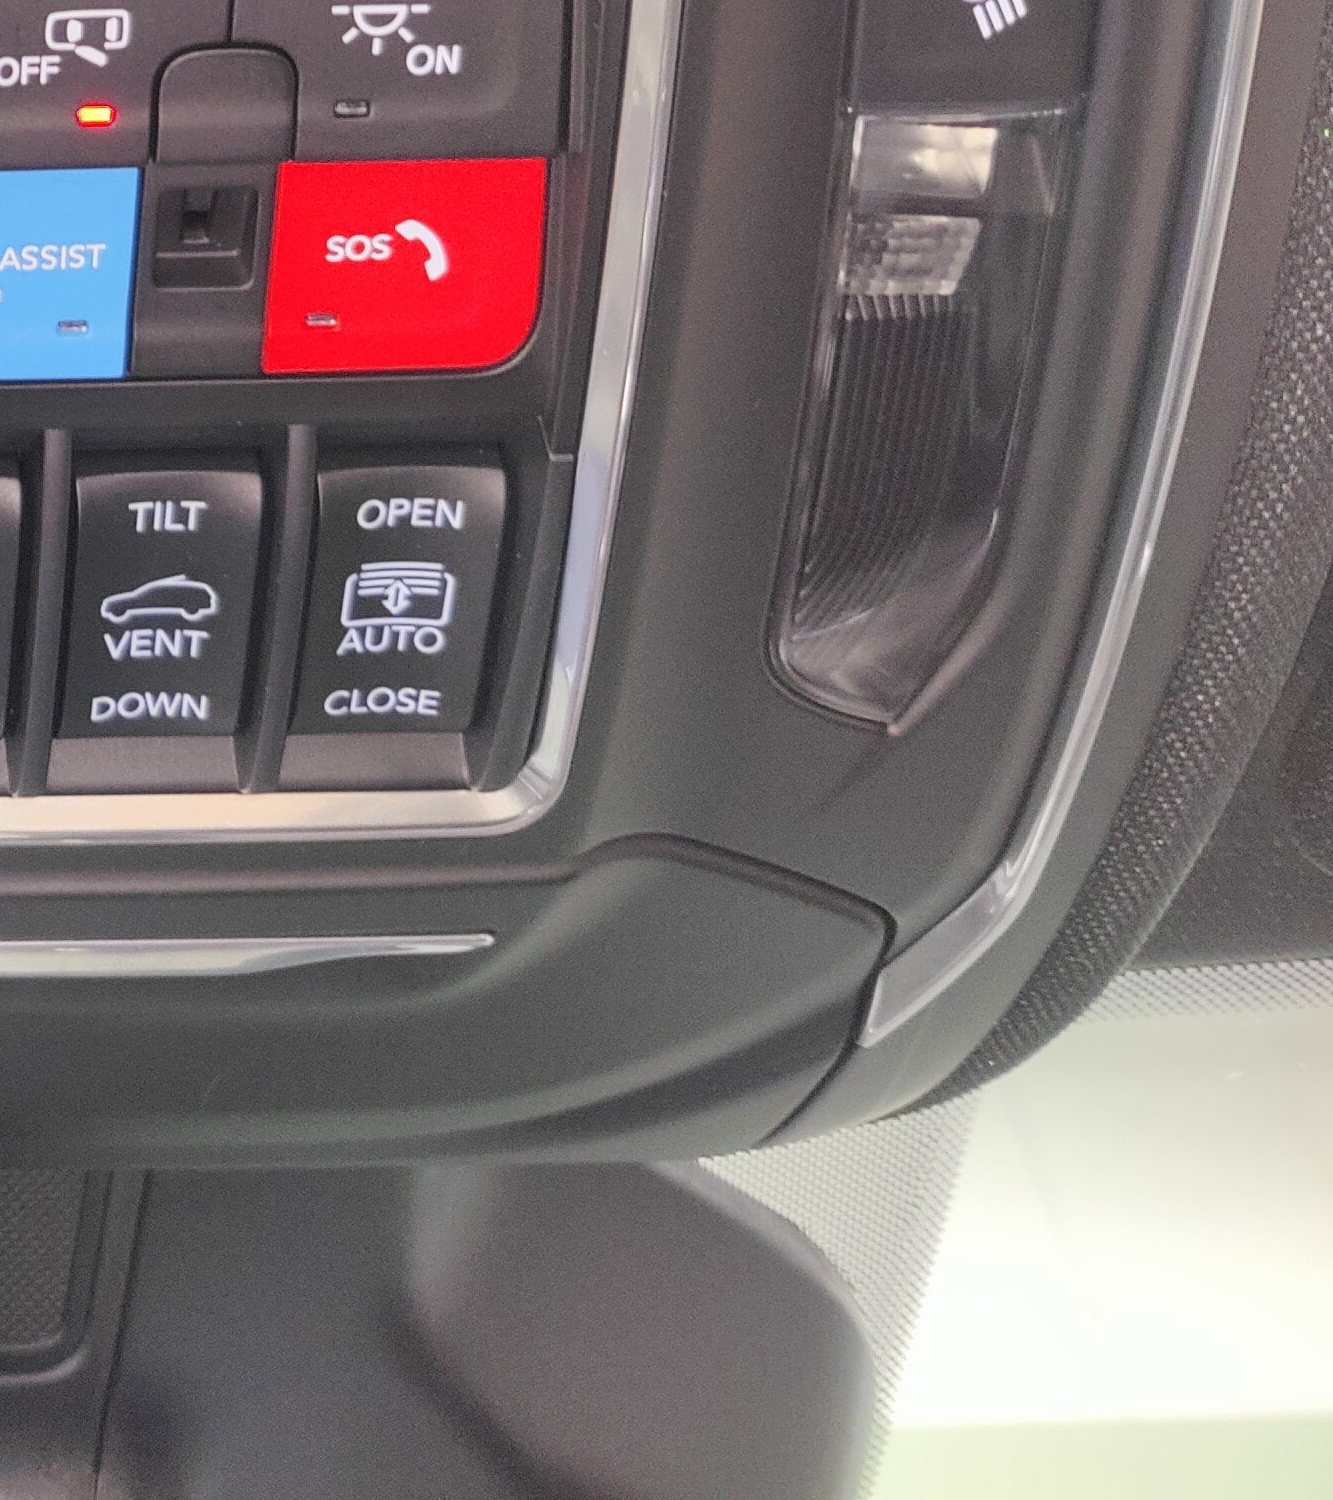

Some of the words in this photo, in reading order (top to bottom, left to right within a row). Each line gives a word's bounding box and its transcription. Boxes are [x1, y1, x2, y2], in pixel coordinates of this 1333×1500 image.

[405, 43, 461, 76] ON
[325, 233, 392, 263] SOS
[129, 501, 206, 532] TILT
[356, 499, 464, 531] OPEN
[104, 630, 208, 659] VENT
[337, 626, 445, 655] AUTO
[91, 693, 208, 722] DOWN
[324, 687, 441, 716] CLOSE
